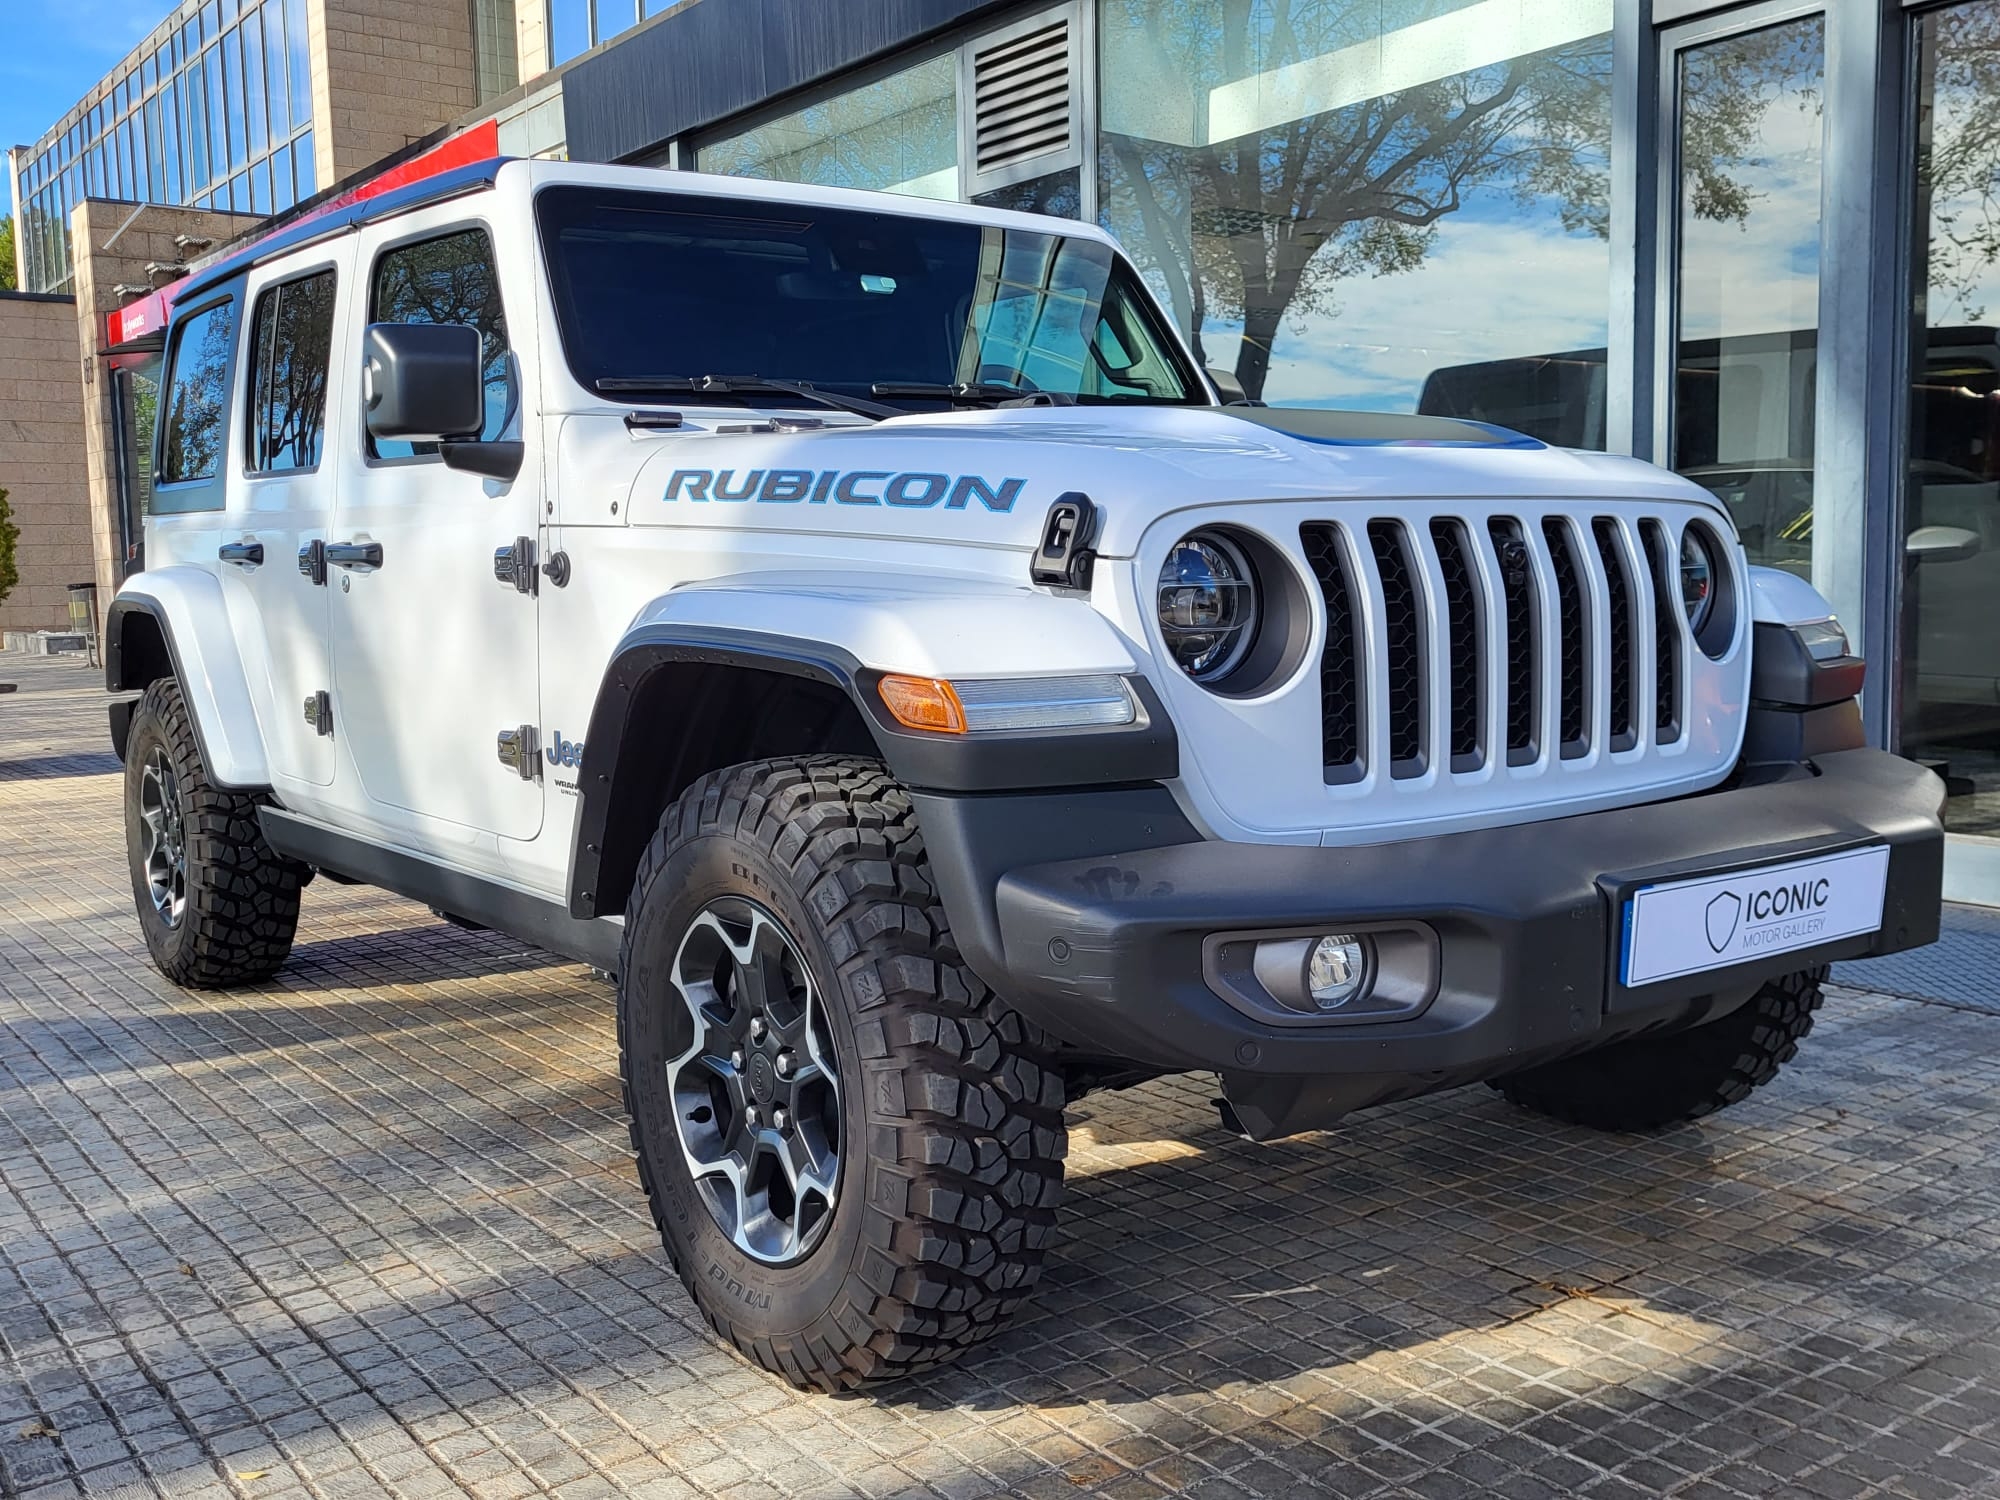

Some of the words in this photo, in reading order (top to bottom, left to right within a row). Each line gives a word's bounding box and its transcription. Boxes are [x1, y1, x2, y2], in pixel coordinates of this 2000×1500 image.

[664, 470, 1026, 512] RUBICON
[1746, 878, 1829, 922] ICONIC
[1743, 928, 1780, 949] MOTOR
[1783, 918, 1825, 939] GALLERY
